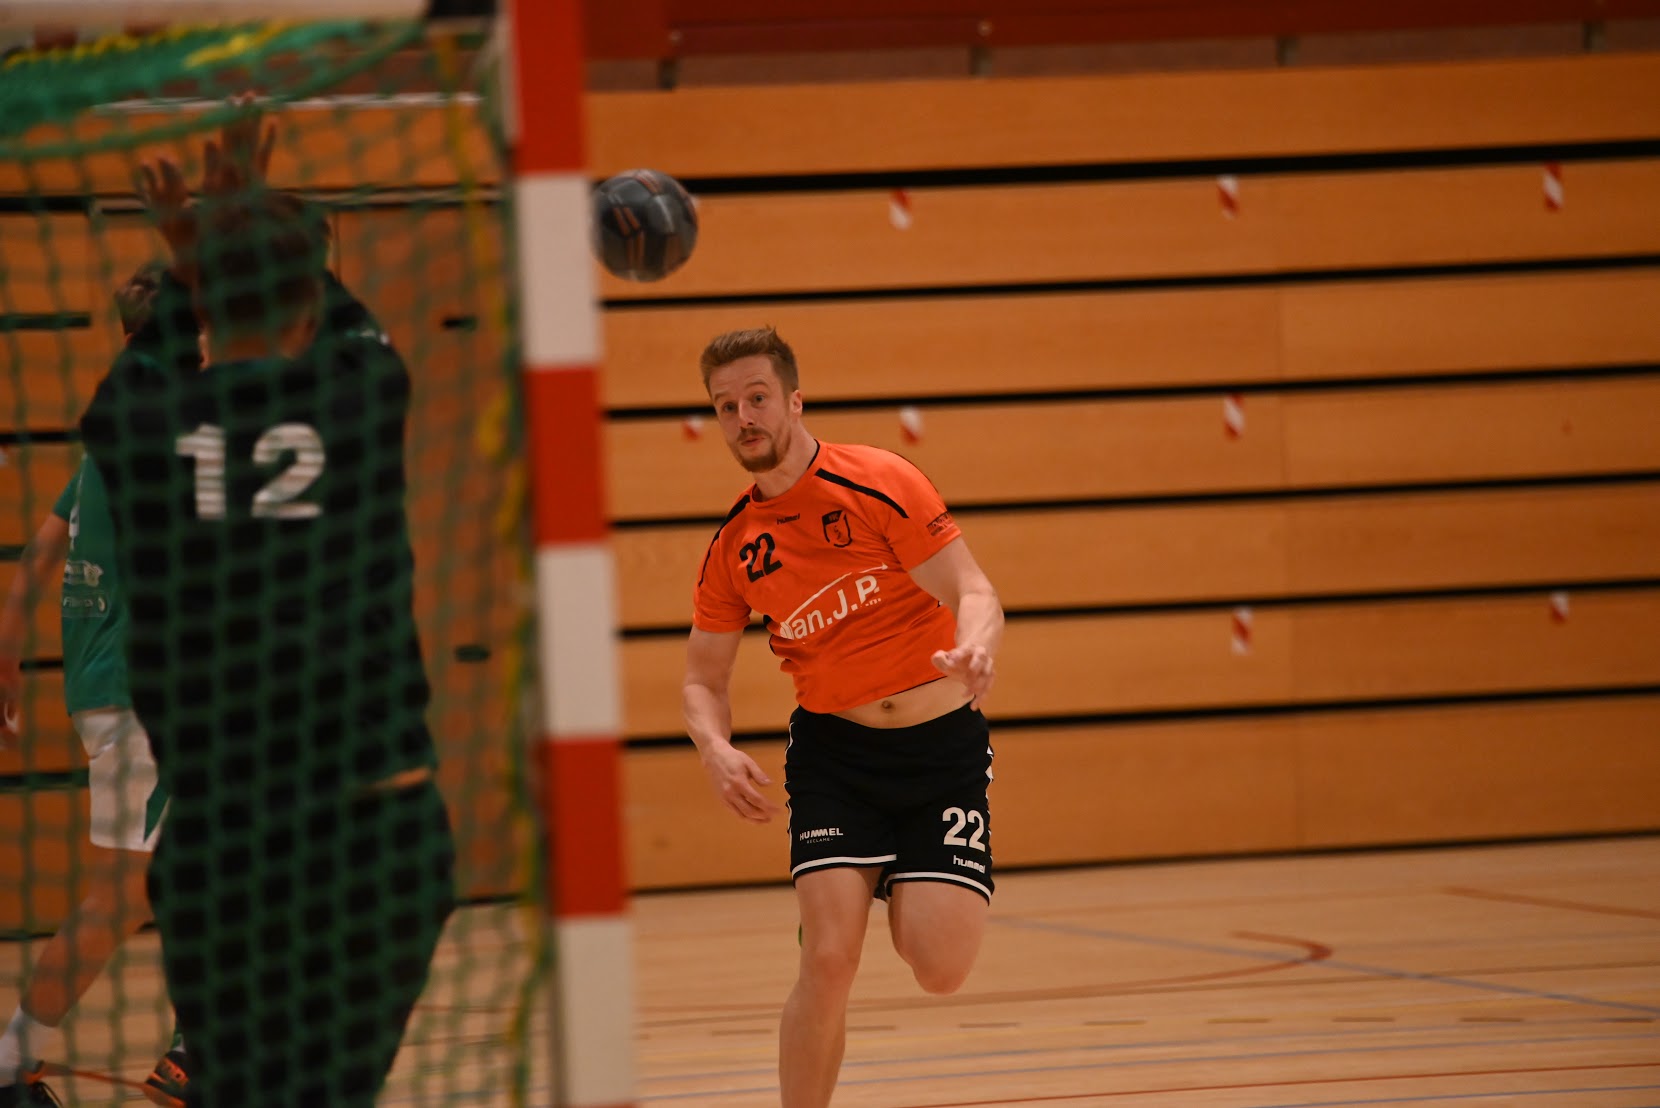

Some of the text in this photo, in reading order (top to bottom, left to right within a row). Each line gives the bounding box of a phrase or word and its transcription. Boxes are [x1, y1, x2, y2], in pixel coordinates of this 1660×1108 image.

[175, 423, 326, 520] 12
[739, 532, 783, 583] 22
[799, 827, 844, 841] HUMMEL
[942, 806, 986, 852] 22
[953, 854, 986, 874] hummel
